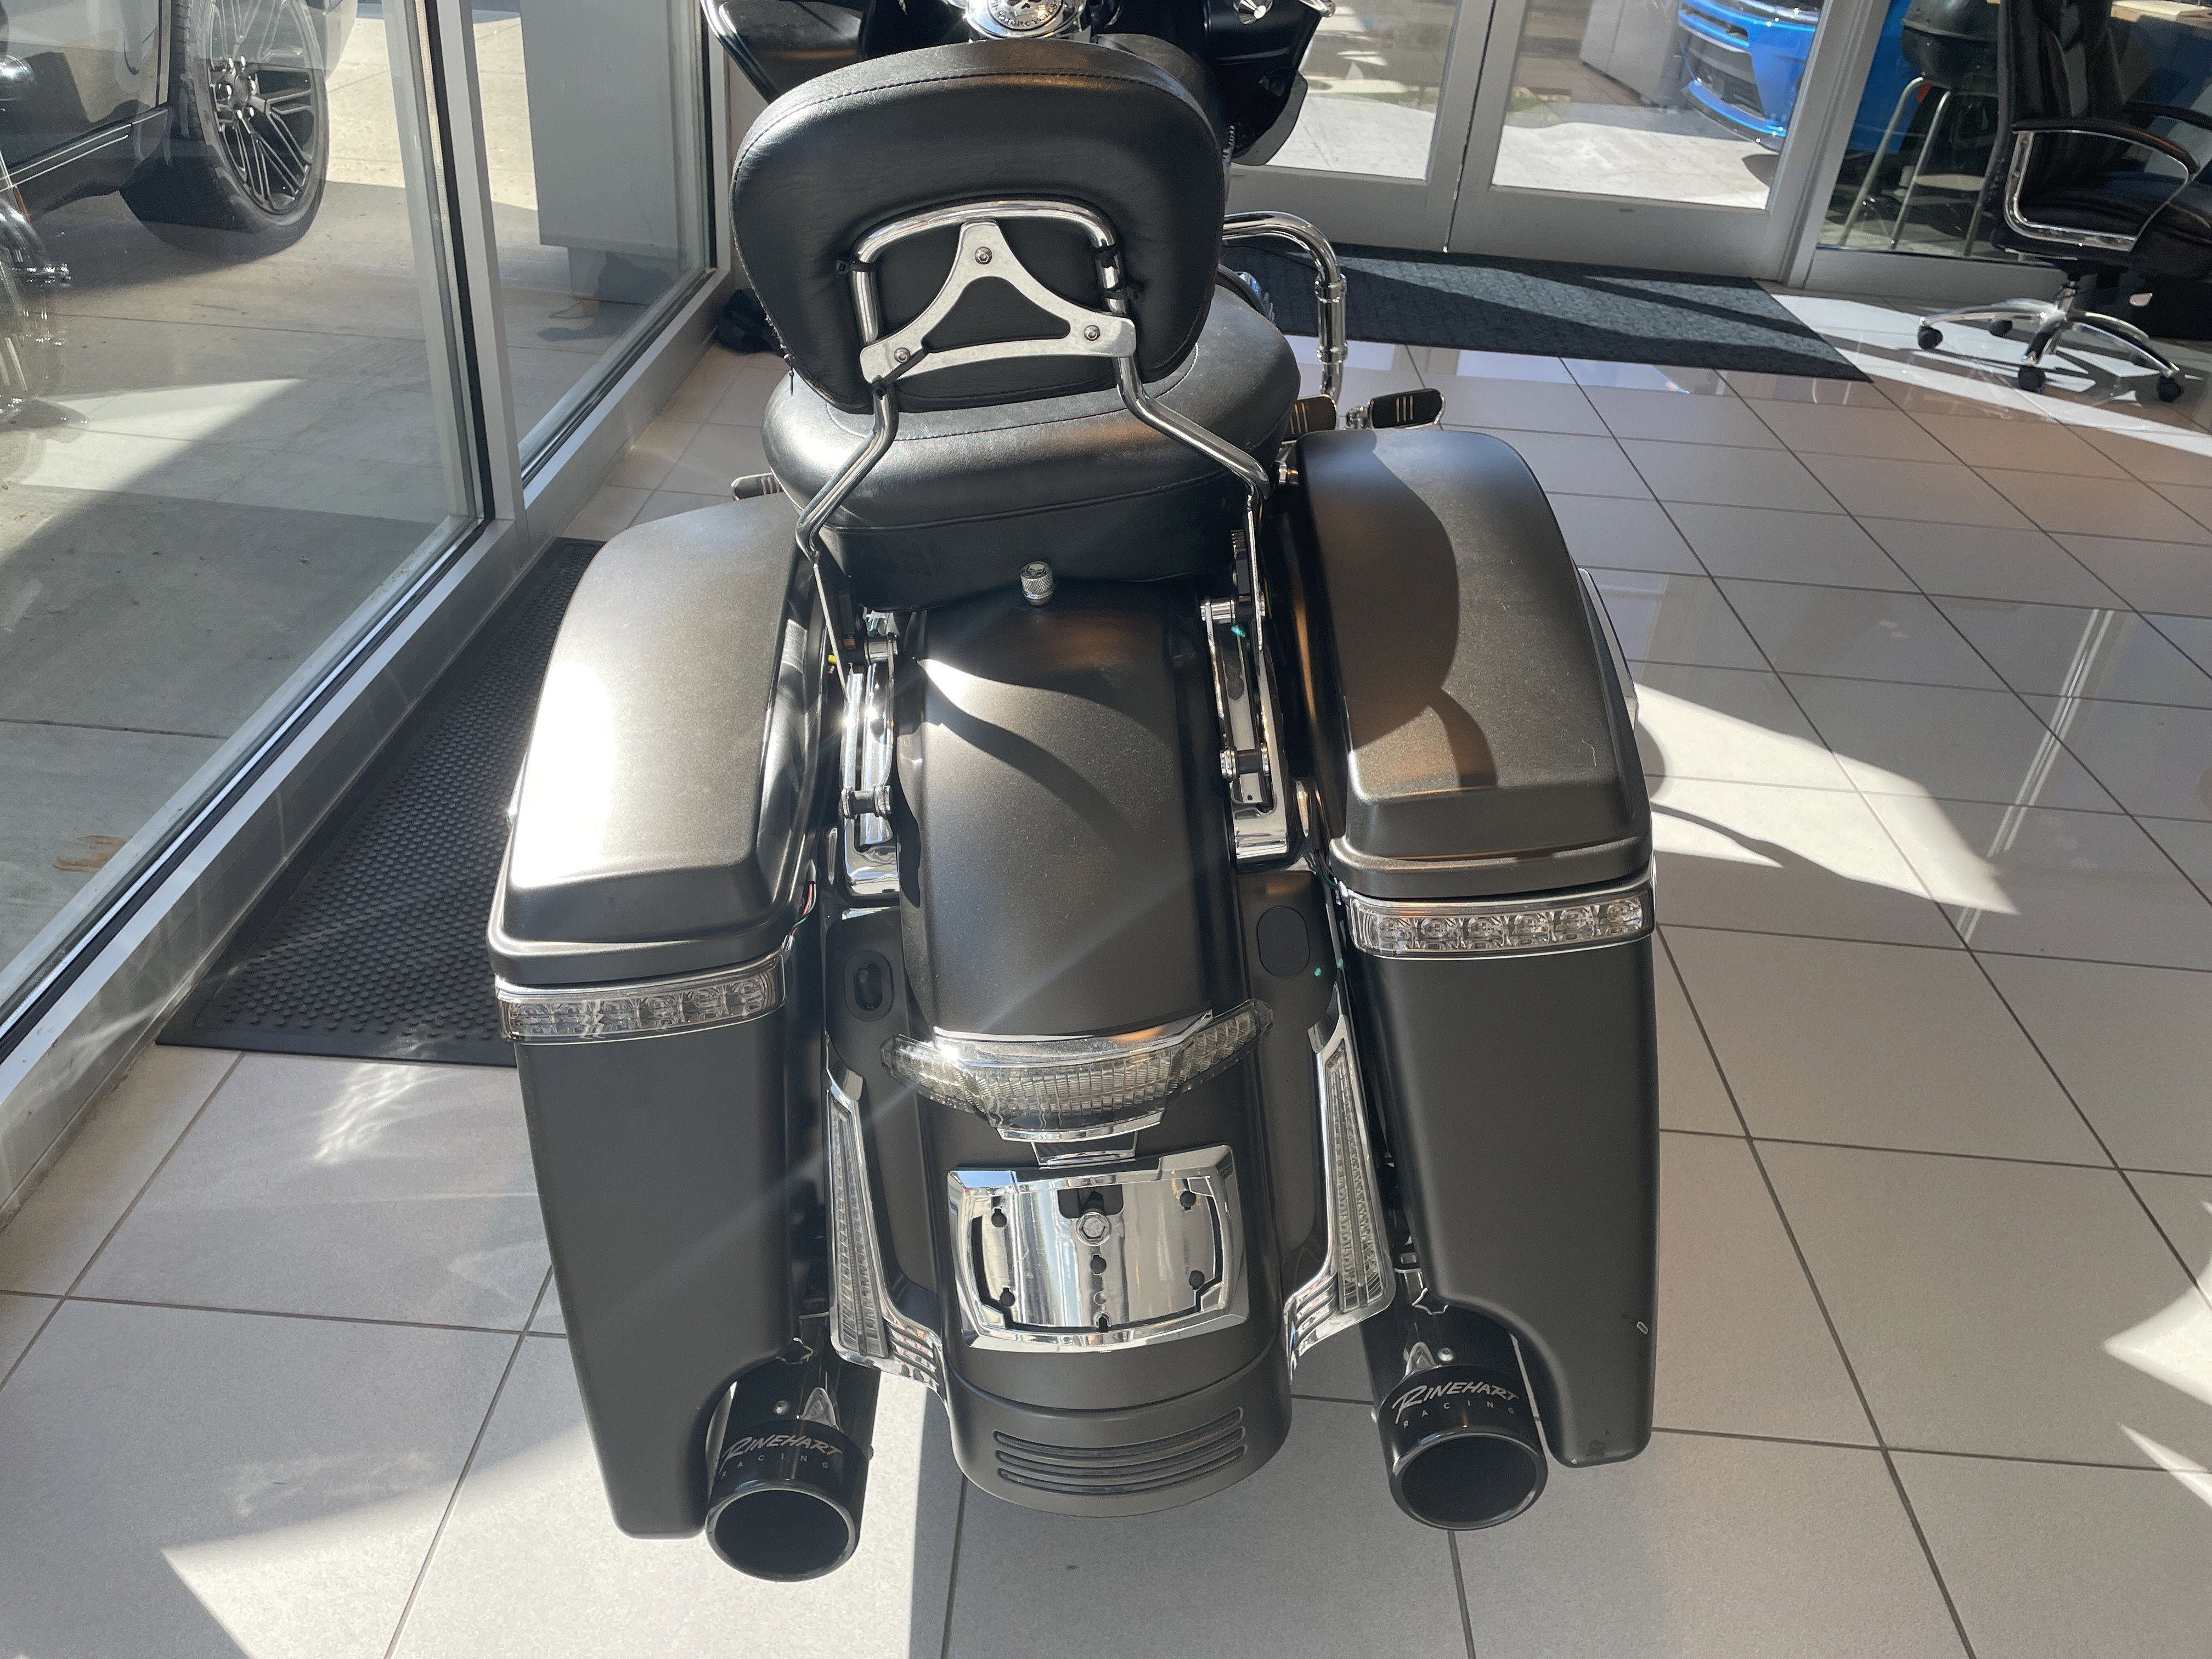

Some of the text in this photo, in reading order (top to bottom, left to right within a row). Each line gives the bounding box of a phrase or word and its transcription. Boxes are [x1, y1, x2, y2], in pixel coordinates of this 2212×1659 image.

[1391, 1381, 1519, 1424] RINEHART
[1403, 1400, 1514, 1429] RACING
[719, 1434, 843, 1474] RINEHART
[721, 1453, 828, 1479] RACING
